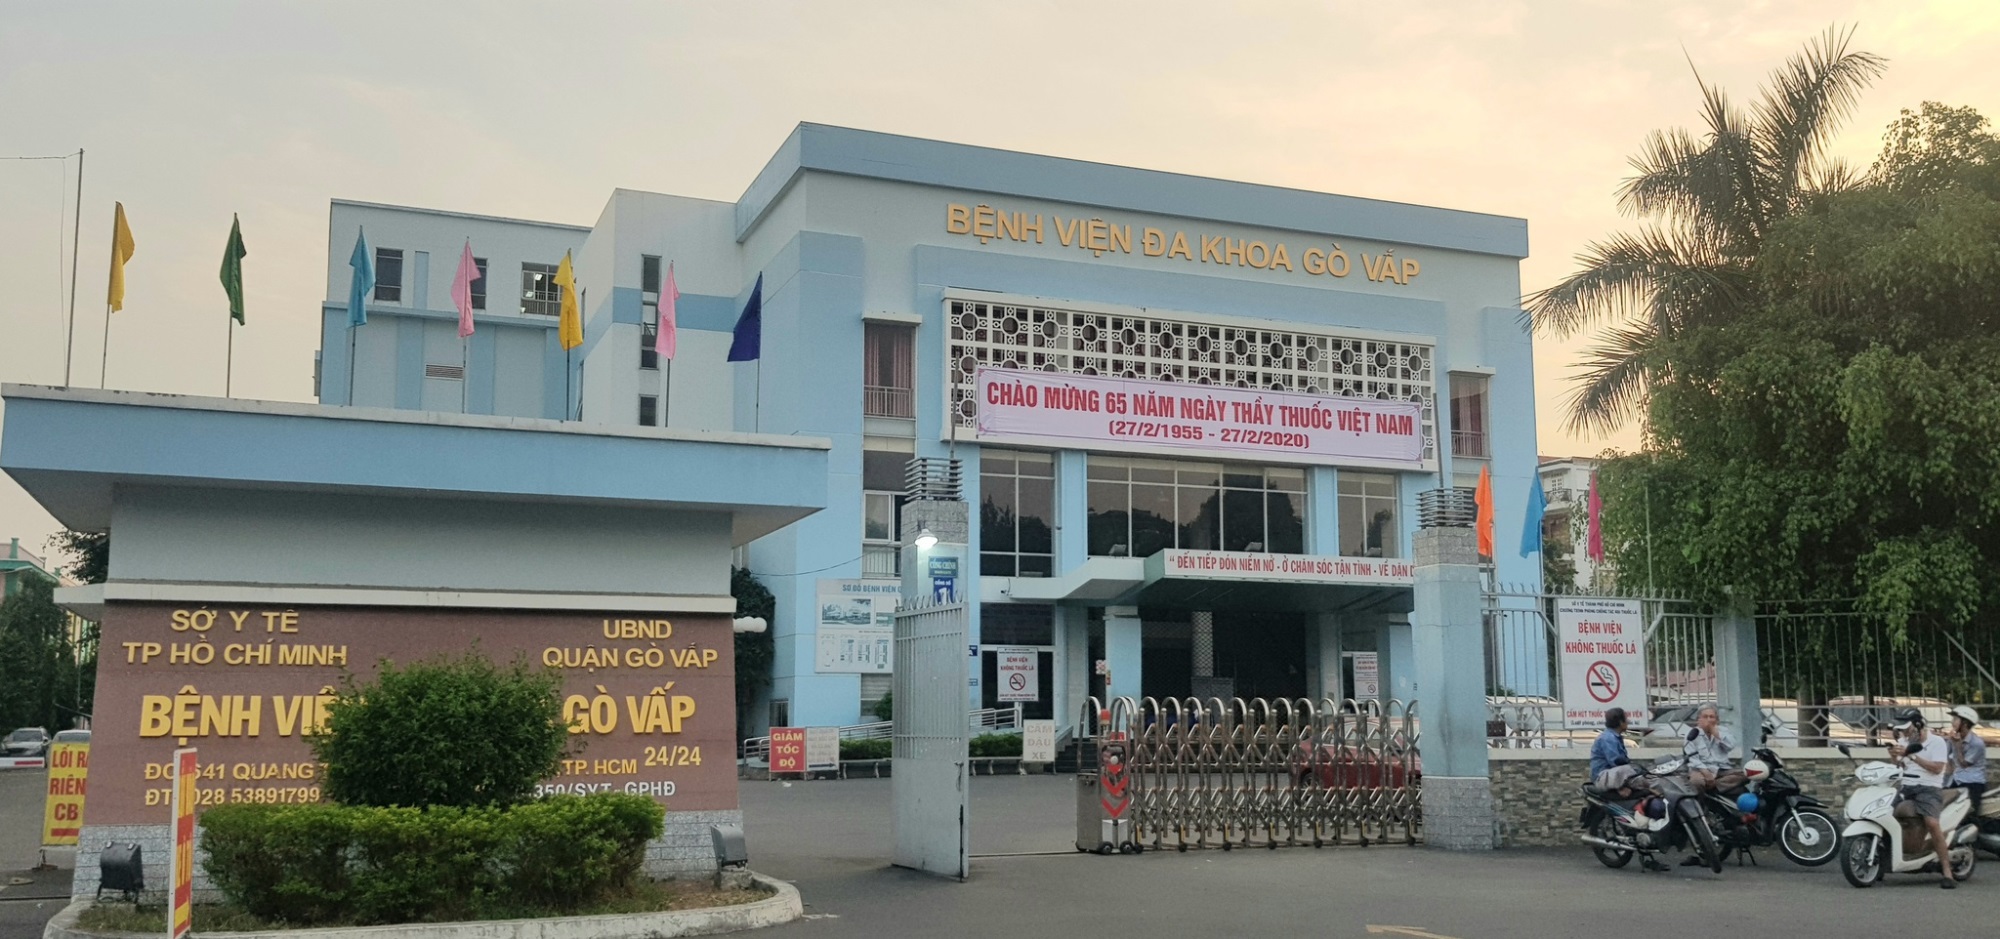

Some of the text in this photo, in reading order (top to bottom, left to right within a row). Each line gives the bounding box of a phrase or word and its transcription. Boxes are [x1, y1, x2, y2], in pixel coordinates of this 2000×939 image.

[946, 203, 1420, 285] BỆNH VIỆN ĐA KHOA GÒ VẤP
[987, 379, 1413, 436] CHÀO MỪNG 65 NĂM NGÀY THẦY THUỐC VIỆT NAM
[1109, 420, 1203, 441] (27/2/1955
[1220, 427, 1309, 449] 27/2/2020)
[1197, 551, 1217, 570] TIẾP
[1219, 554, 1237, 571] ĐÓN
[1263, 555, 1275, 572] NỞ
[1291, 558, 1314, 574] CHĂM
[1316, 558, 1332, 575] SÓC
[1335, 559, 1351, 578] TẬN
[1353, 560, 1371, 576] TÌNH
[1392, 562, 1408, 581] DẶN
[882, 584, 896, 594] VIỆN
[229, 611, 249, 631] Y
[604, 619, 672, 639] UBND
[1578, 619, 1622, 636] BỆNH VIỆN
[122, 634, 347, 666] TP HỒ CHÍ MINH
[1565, 639, 1636, 654] KHÔNG THUỐC LÁ
[543, 642, 718, 673] QUẬN GÒ VẤP
[139, 685, 262, 746] BỆNH
[273, 685, 341, 737] VIỆ
[563, 684, 618, 734] GÒ
[626, 681, 696, 734] VẤP
[773, 730, 803, 741] GIẢM
[52, 744, 73, 768] LỐI
[645, 746, 701, 767] 24/24
[776, 742, 799, 754] TỐC
[1032, 751, 1047, 760] XE
[233, 763, 314, 781] QUANG
[594, 759, 637, 774] HCM
[779, 756, 796, 769] ĐỘ
[49, 774, 87, 796] RIÊN
[231, 786, 320, 805] 53891799
[54, 803, 79, 821] CB
